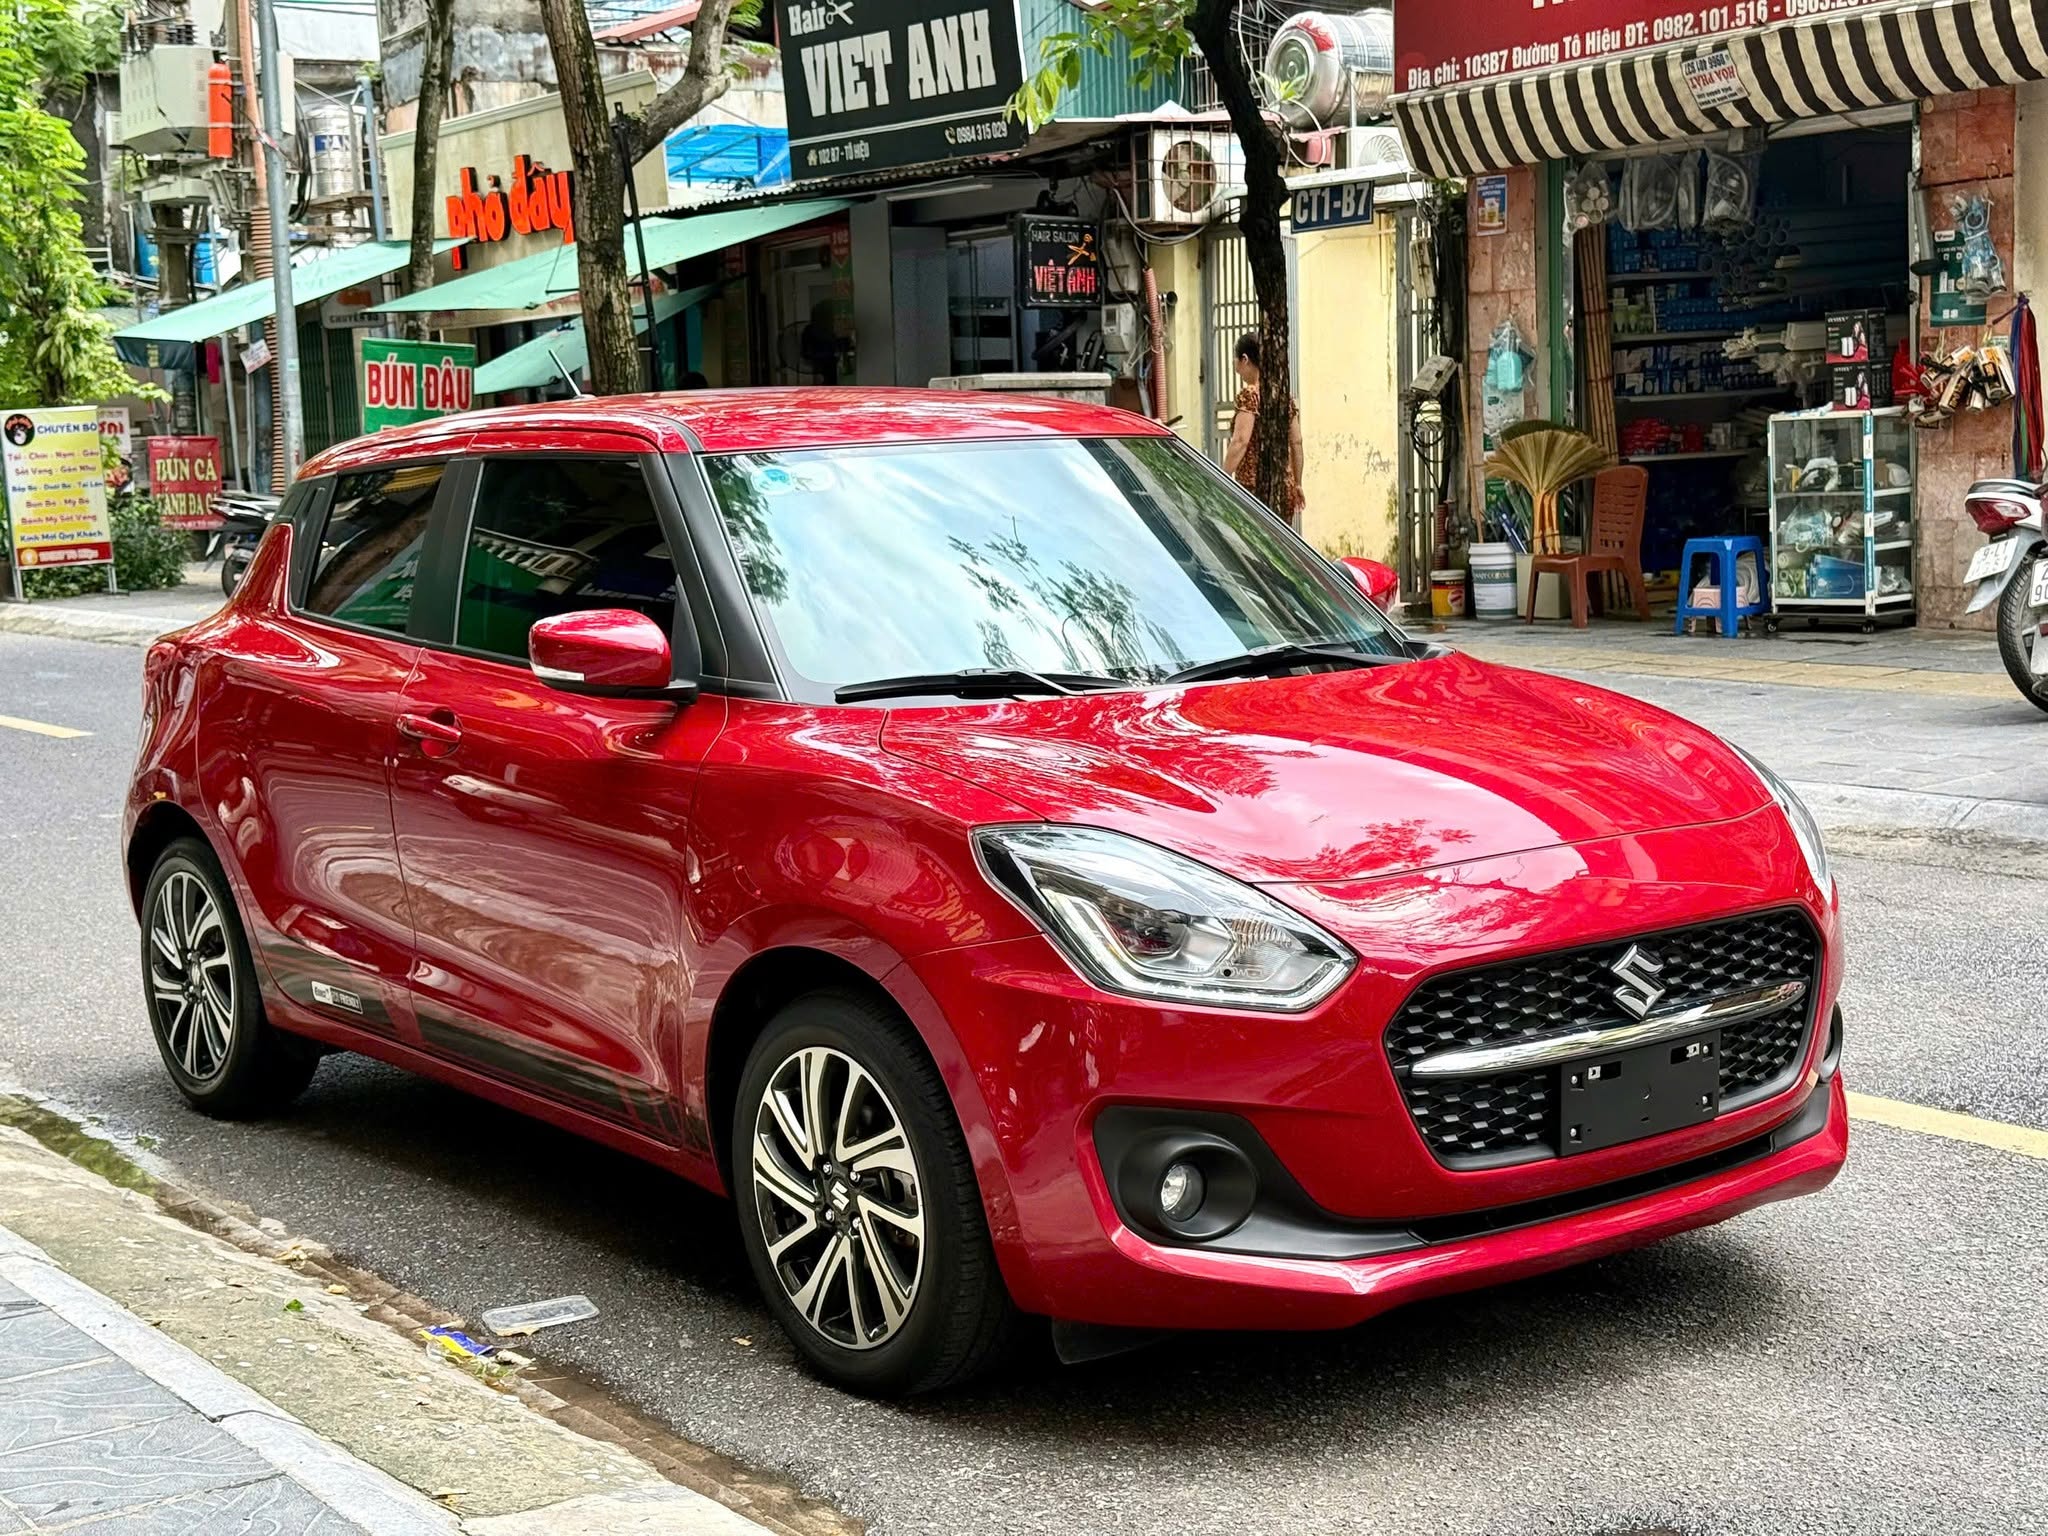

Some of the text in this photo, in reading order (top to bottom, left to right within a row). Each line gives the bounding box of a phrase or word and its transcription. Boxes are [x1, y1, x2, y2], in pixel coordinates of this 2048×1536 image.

[788, 1, 826, 36] Hair
[1464, 49, 1509, 79] 103B7
[1512, 42, 1559, 70] Đường
[1563, 33, 1581, 59] Tô
[1585, 27, 1621, 56] Hiệu
[1625, 21, 1649, 47] ĐT:
[1653, 0, 1768, 42] 0982.101.516
[908, 8, 997, 100] ANH
[445, 154, 574, 271] phở đây
[1295, 181, 1369, 224] CT1-B7
[1031, 230, 1079, 243] HAIR SALON
[1033, 258, 1096, 300] VIỆT ANH
[365, 352, 417, 409] BÚN
[155, 452, 218, 482] BÚN CÁ
[188, 492, 204, 516] ĐA
